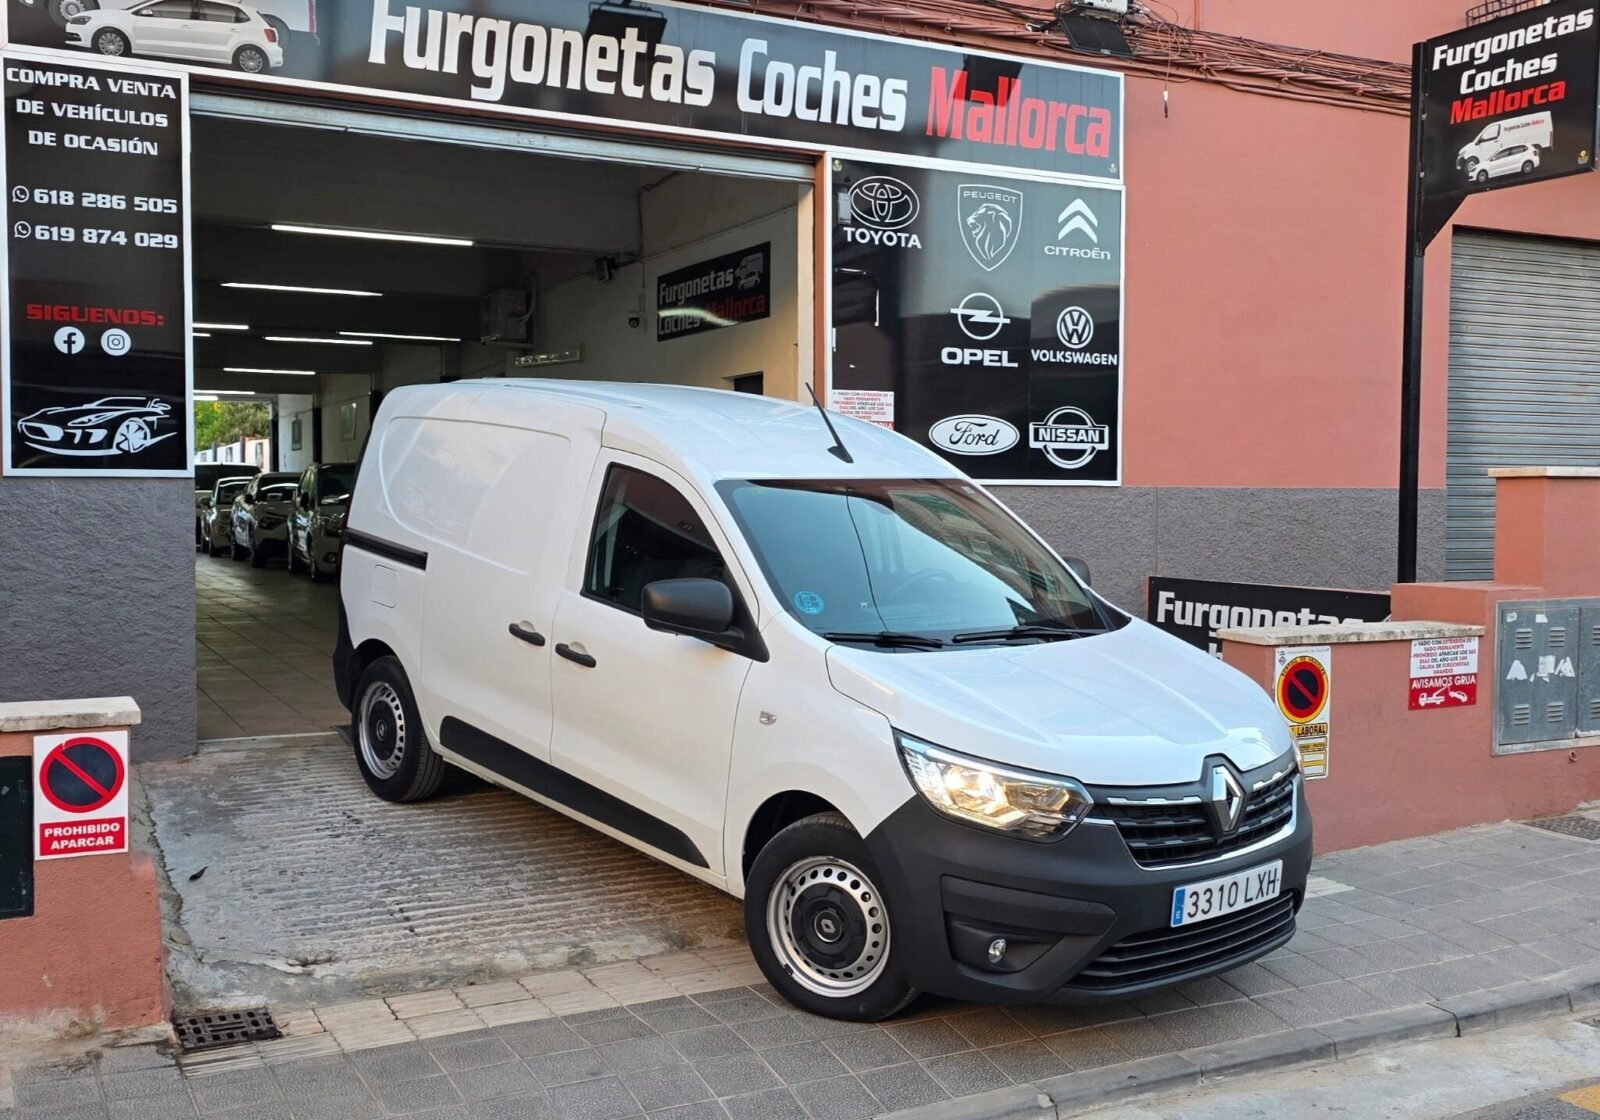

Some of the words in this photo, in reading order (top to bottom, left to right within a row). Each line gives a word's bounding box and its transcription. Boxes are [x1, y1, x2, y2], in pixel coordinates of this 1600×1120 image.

[1432, 9, 1594, 71] Furgonetas
[6, 68, 100, 91] COMPRA
[107, 79, 176, 99] VENTA
[368, 0, 716, 107] Furgonetas
[737, 38, 908, 132] Coches
[926, 66, 1111, 158] Mallorca
[1460, 53, 1558, 94] Coches
[16, 99, 44, 115] DE
[52, 102, 169, 127] VEHÍCULOS
[1451, 81, 1566, 124] Mallorca
[28, 130, 57, 146] DE
[64, 133, 158, 156] OCASIÓN
[34, 188, 74, 206] 618
[82, 192, 126, 210] 286
[134, 196, 177, 214] 505
[963, 190, 1018, 204] PEUGEOT
[35, 225, 75, 242] 619
[83, 228, 127, 246] 874
[135, 232, 178, 249] 029
[843, 227, 922, 249] TOYOTA
[660, 268, 734, 305] Furgonetas
[27, 304, 164, 325] SIGUENOS:
[941, 347, 1018, 367] OPEL
[1031, 348, 1117, 366] VOLKSWAGEN
[949, 421, 1000, 446] Ford
[1038, 428, 1100, 443] NISSAN
[1412, 676, 1453, 689] AVISAMOS
[1454, 675, 1477, 685] GRUA
[1297, 725, 1325, 736] LABORAL
[44, 822, 120, 838] PROHIBIDO
[51, 835, 114, 850] APARCAR
[1187, 881, 1239, 918] 3310
[1244, 868, 1278, 903] LXH
